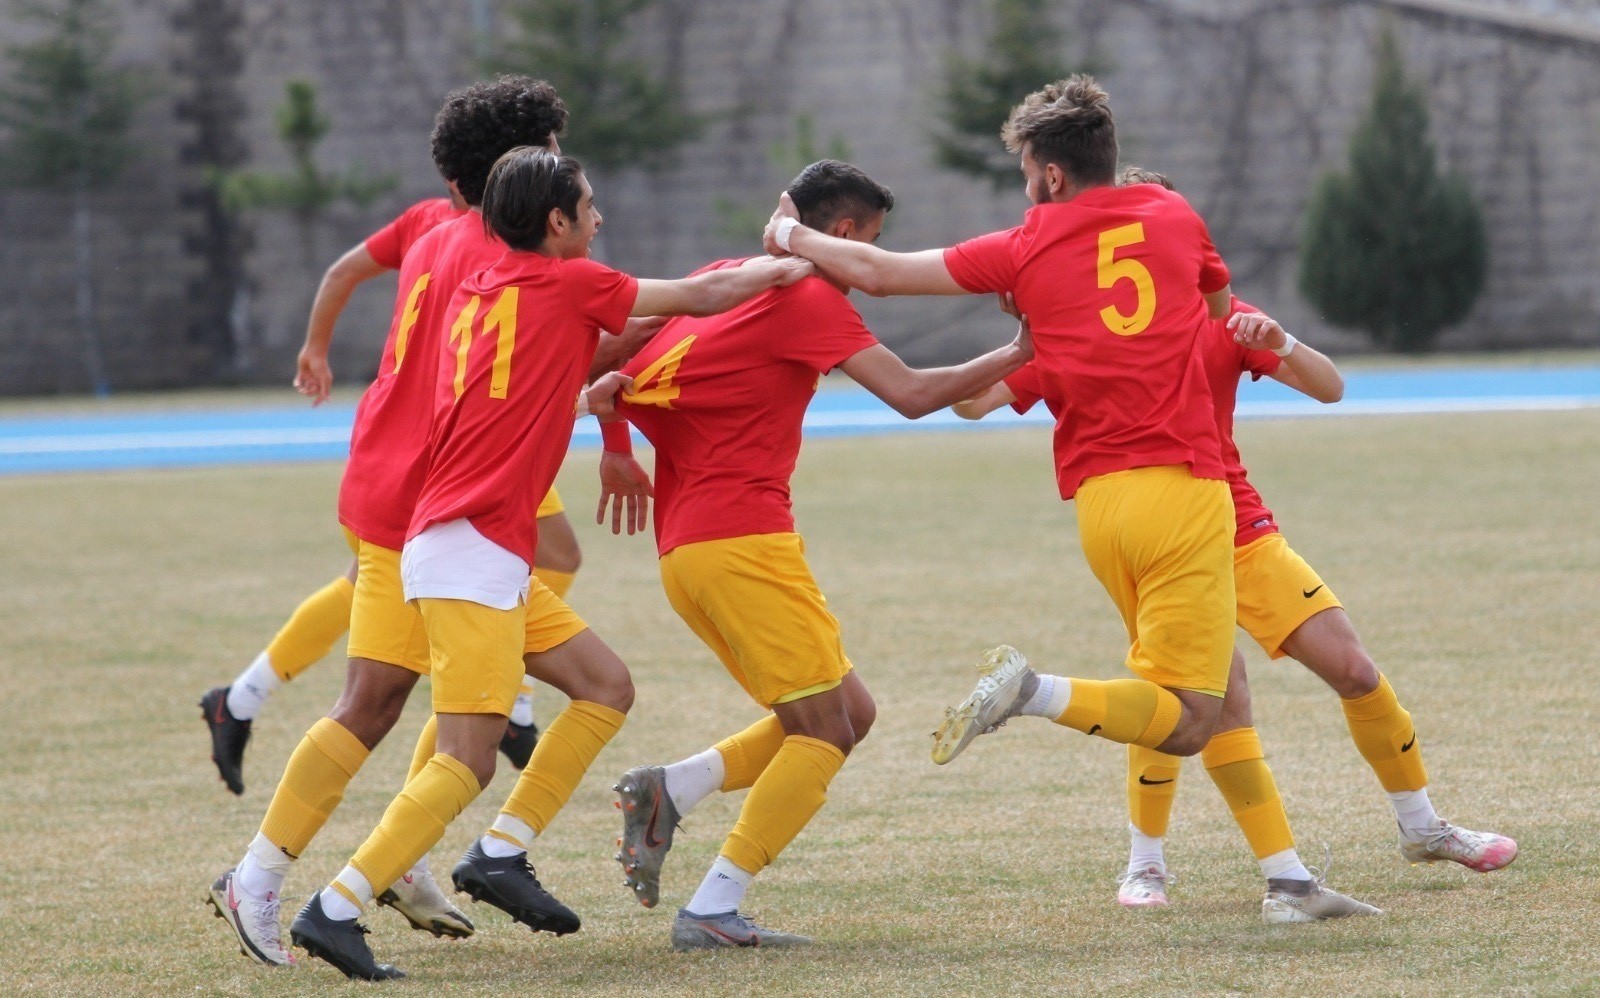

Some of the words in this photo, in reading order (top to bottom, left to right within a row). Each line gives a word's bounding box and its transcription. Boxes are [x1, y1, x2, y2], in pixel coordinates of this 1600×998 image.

[1097, 222, 1156, 336] 5
[449, 286, 519, 402] 11
[622, 334, 697, 410] 4
